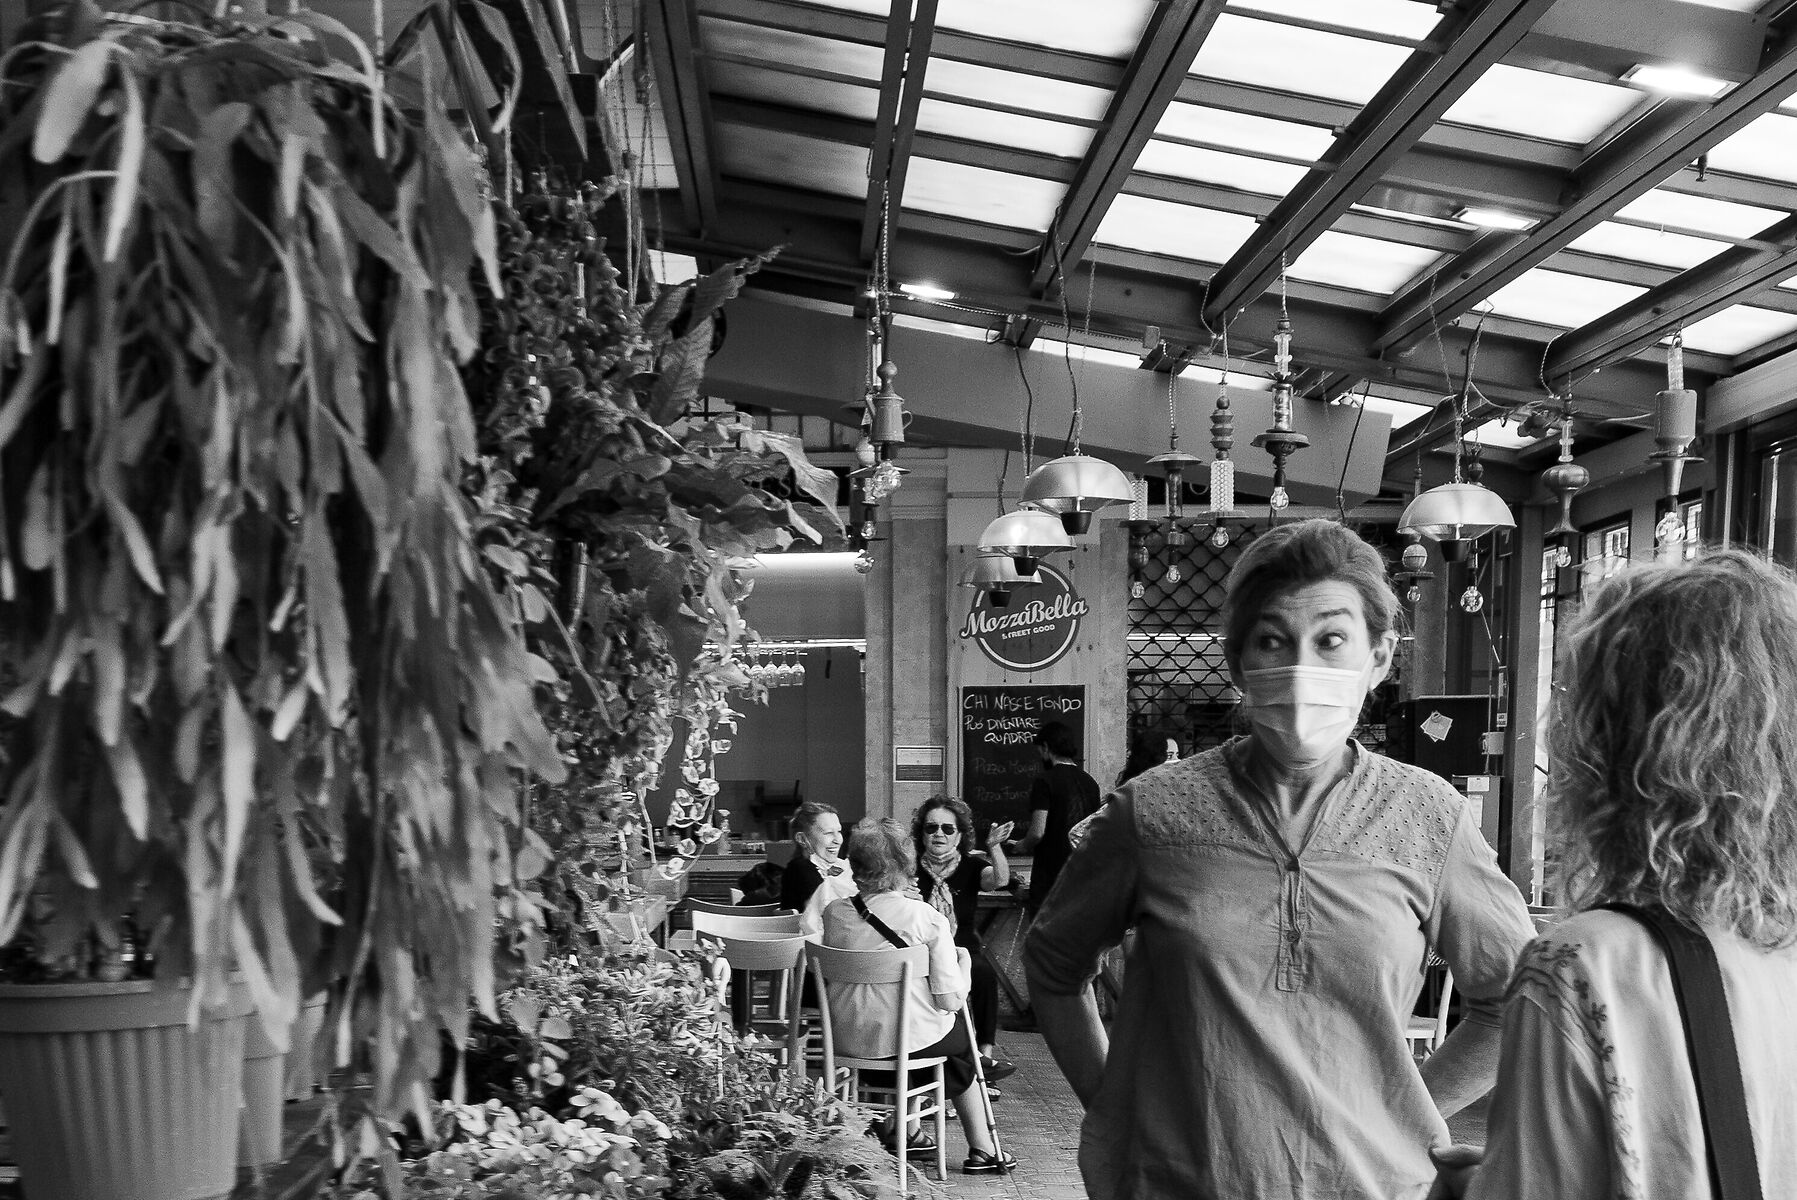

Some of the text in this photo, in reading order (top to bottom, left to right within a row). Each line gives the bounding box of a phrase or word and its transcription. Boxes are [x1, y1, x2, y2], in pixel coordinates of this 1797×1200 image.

[961, 592, 1088, 637] MozzaBella
[1001, 628, 1032, 640] STREET
[963, 692, 1082, 713] CHI NASCE TONDO
[987, 716, 1043, 730] DIVENTARE
